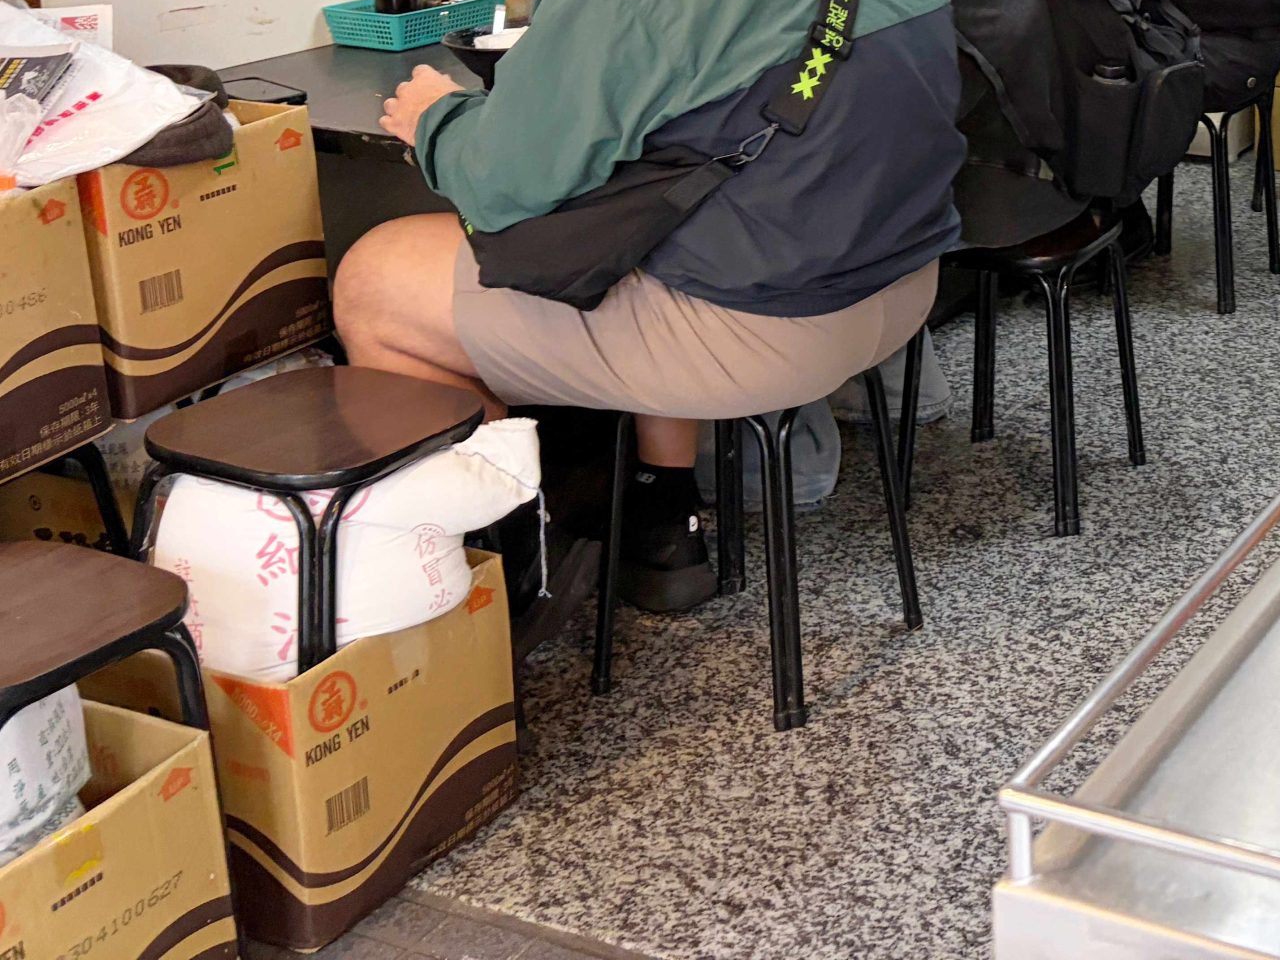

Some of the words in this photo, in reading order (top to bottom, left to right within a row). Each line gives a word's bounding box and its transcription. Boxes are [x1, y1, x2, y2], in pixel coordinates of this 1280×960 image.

[118, 223, 153, 248] KONG
[157, 214, 182, 235] YEN
[305, 733, 341, 768] KONG
[346, 714, 371, 743] YEN
